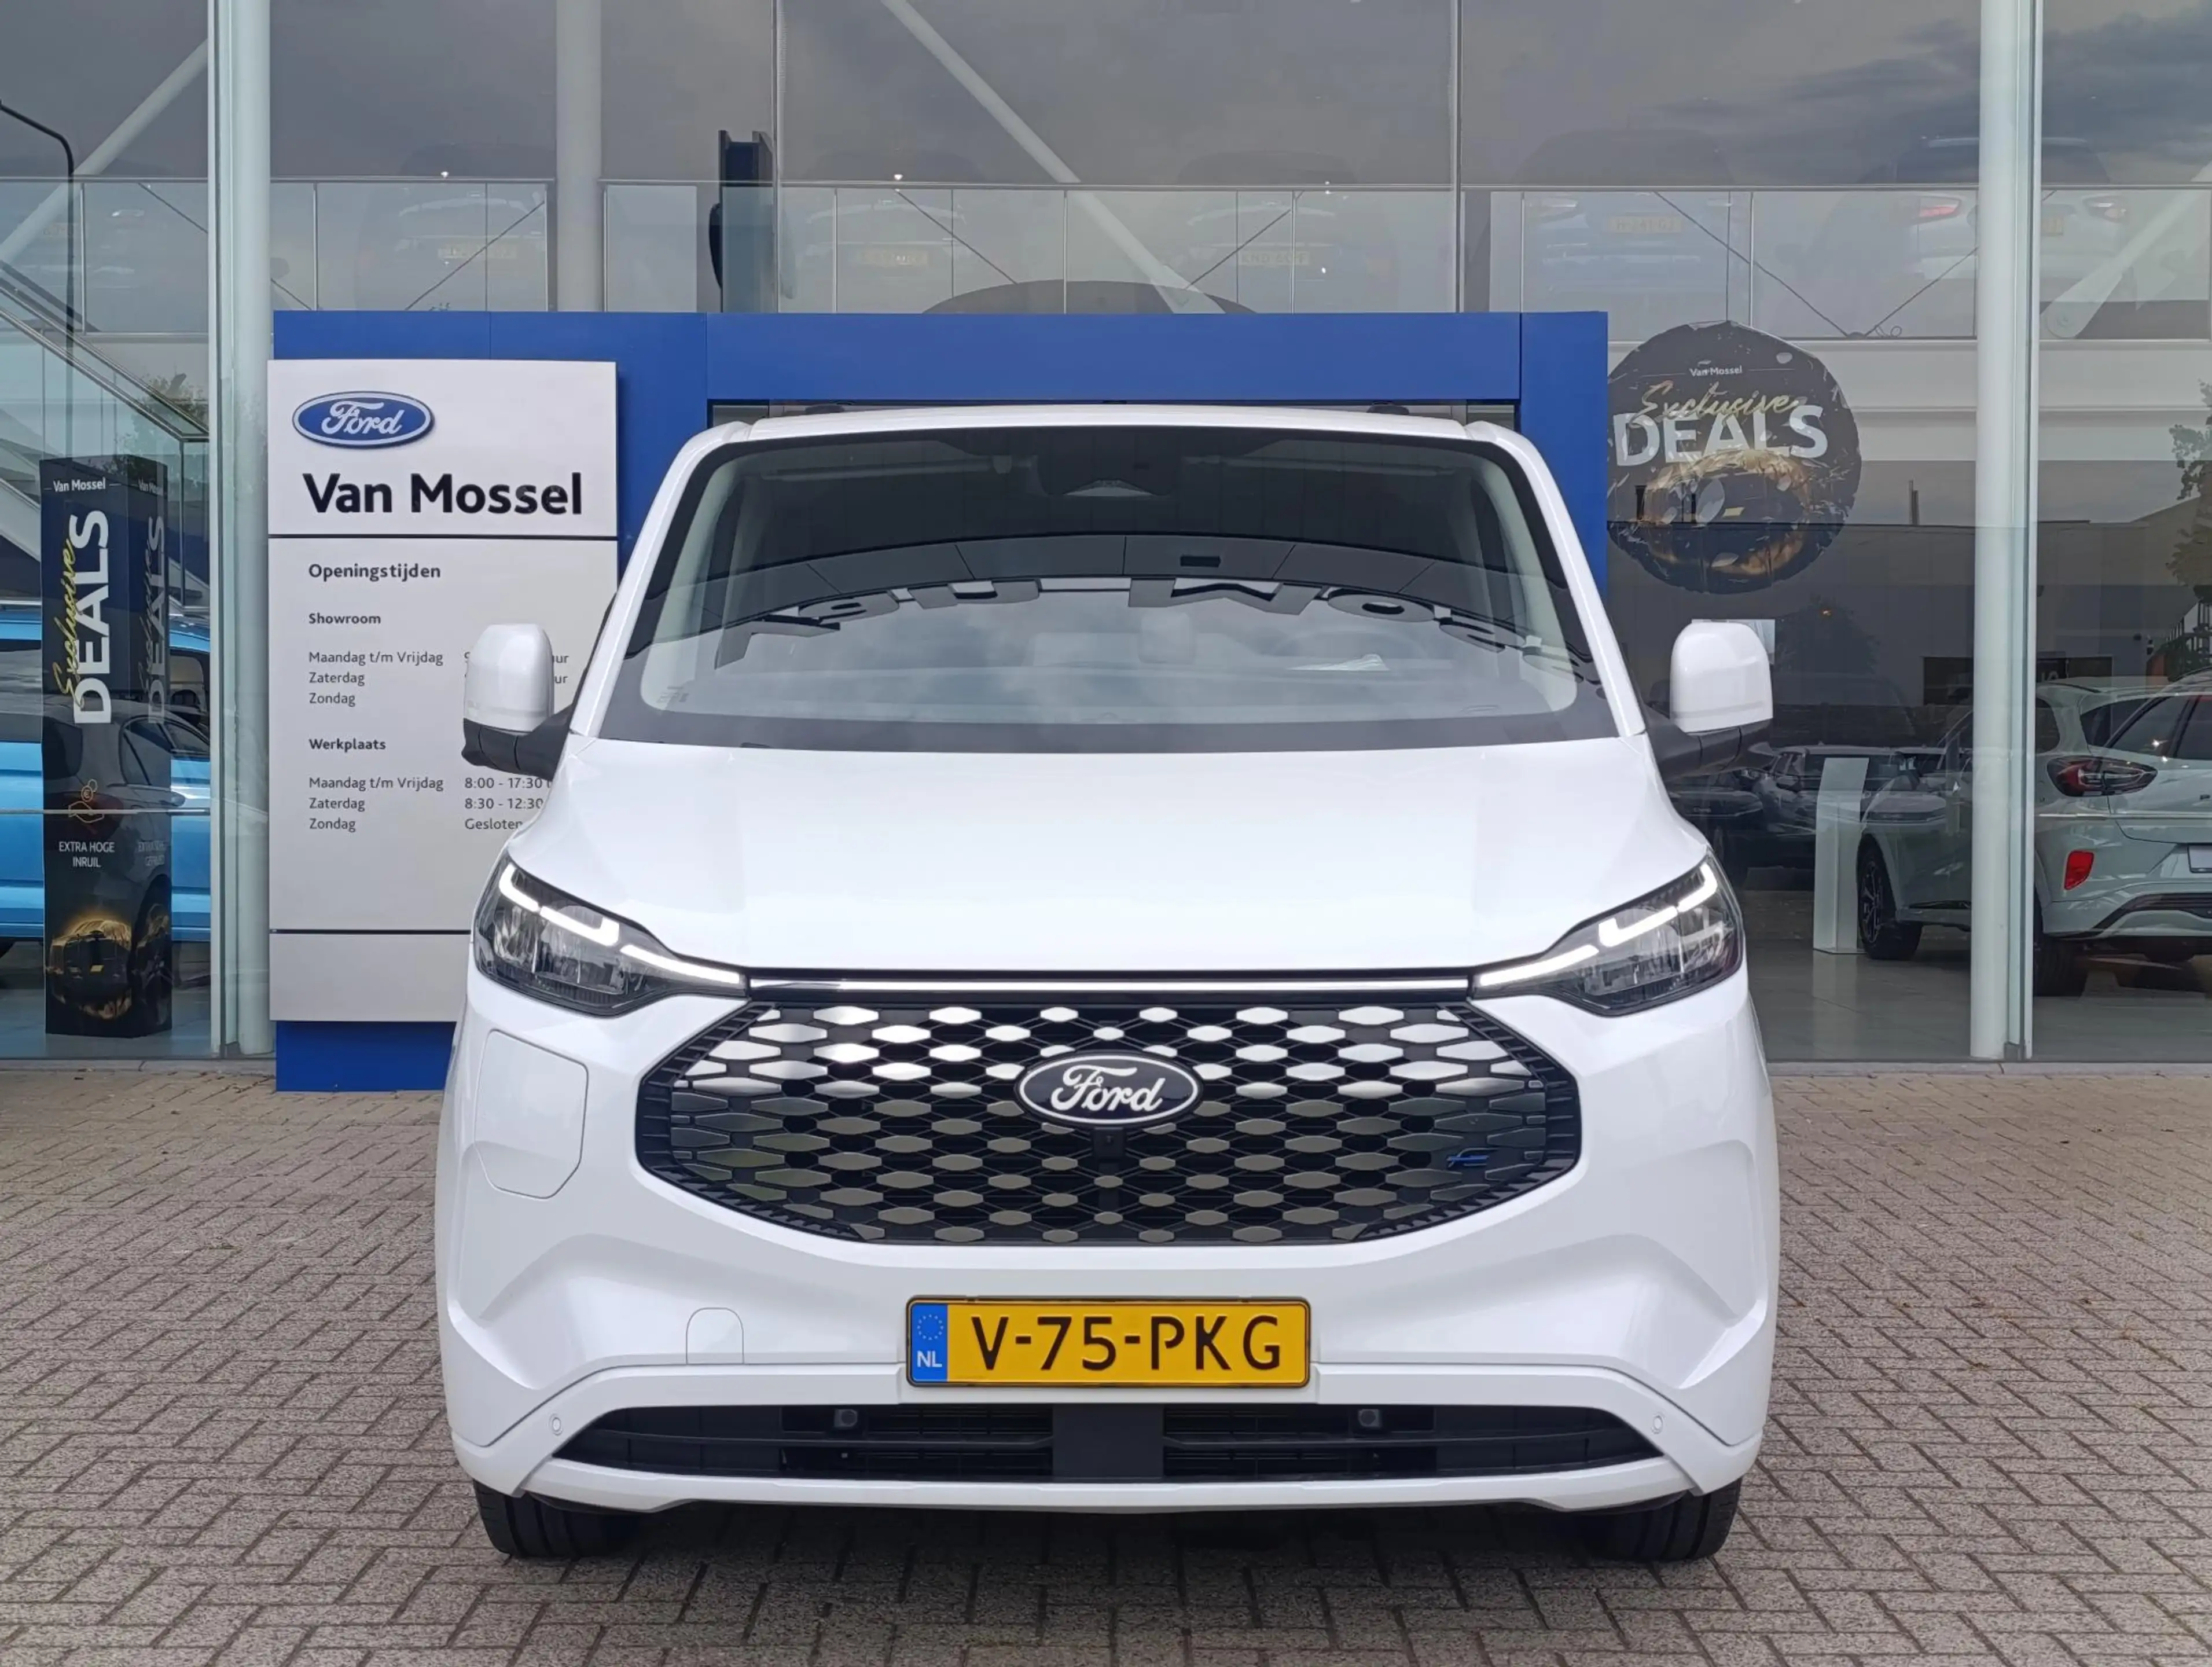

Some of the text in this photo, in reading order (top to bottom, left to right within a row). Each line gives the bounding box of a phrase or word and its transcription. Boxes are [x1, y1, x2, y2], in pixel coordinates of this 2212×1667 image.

[1689, 365, 1743, 377] Van Mossel
[322, 401, 403, 435] Ford
[1613, 405, 1828, 467] DEALS
[53, 476, 106, 492] Van Mossel
[302, 472, 582, 515] Van Mossel
[308, 563, 441, 582] Openingstijden
[52, 538, 85, 710] Exclusive
[69, 509, 112, 724] DEALS
[148, 515, 166, 724] DEALS
[308, 612, 381, 625] Showroom
[308, 651, 366, 666] Maandag
[369, 651, 394, 663] t/m
[398, 651, 444, 667] Vrijdag
[308, 672, 365, 686] Zaterdag
[308, 692, 356, 707] Zondag
[308, 739, 387, 752] Werkplaats
[308, 777, 366, 792] Maandag
[370, 777, 394, 789] t/m
[397, 777, 444, 792] Vrijdag
[464, 777, 495, 789] 8:00
[507, 777, 543, 789] 17:30
[308, 798, 365, 812] Zaterdag
[464, 798, 495, 809] 8:30
[506, 798, 544, 809] 12:30
[308, 818, 357, 832] Zondag
[58, 841, 115, 853] EXTRA HOGE
[72, 856, 102, 868] INRUIL
[1050, 1064, 1166, 1112] Ford
[971, 1315, 1280, 1371] V-75-PKG
[917, 1350, 942, 1368] NL
